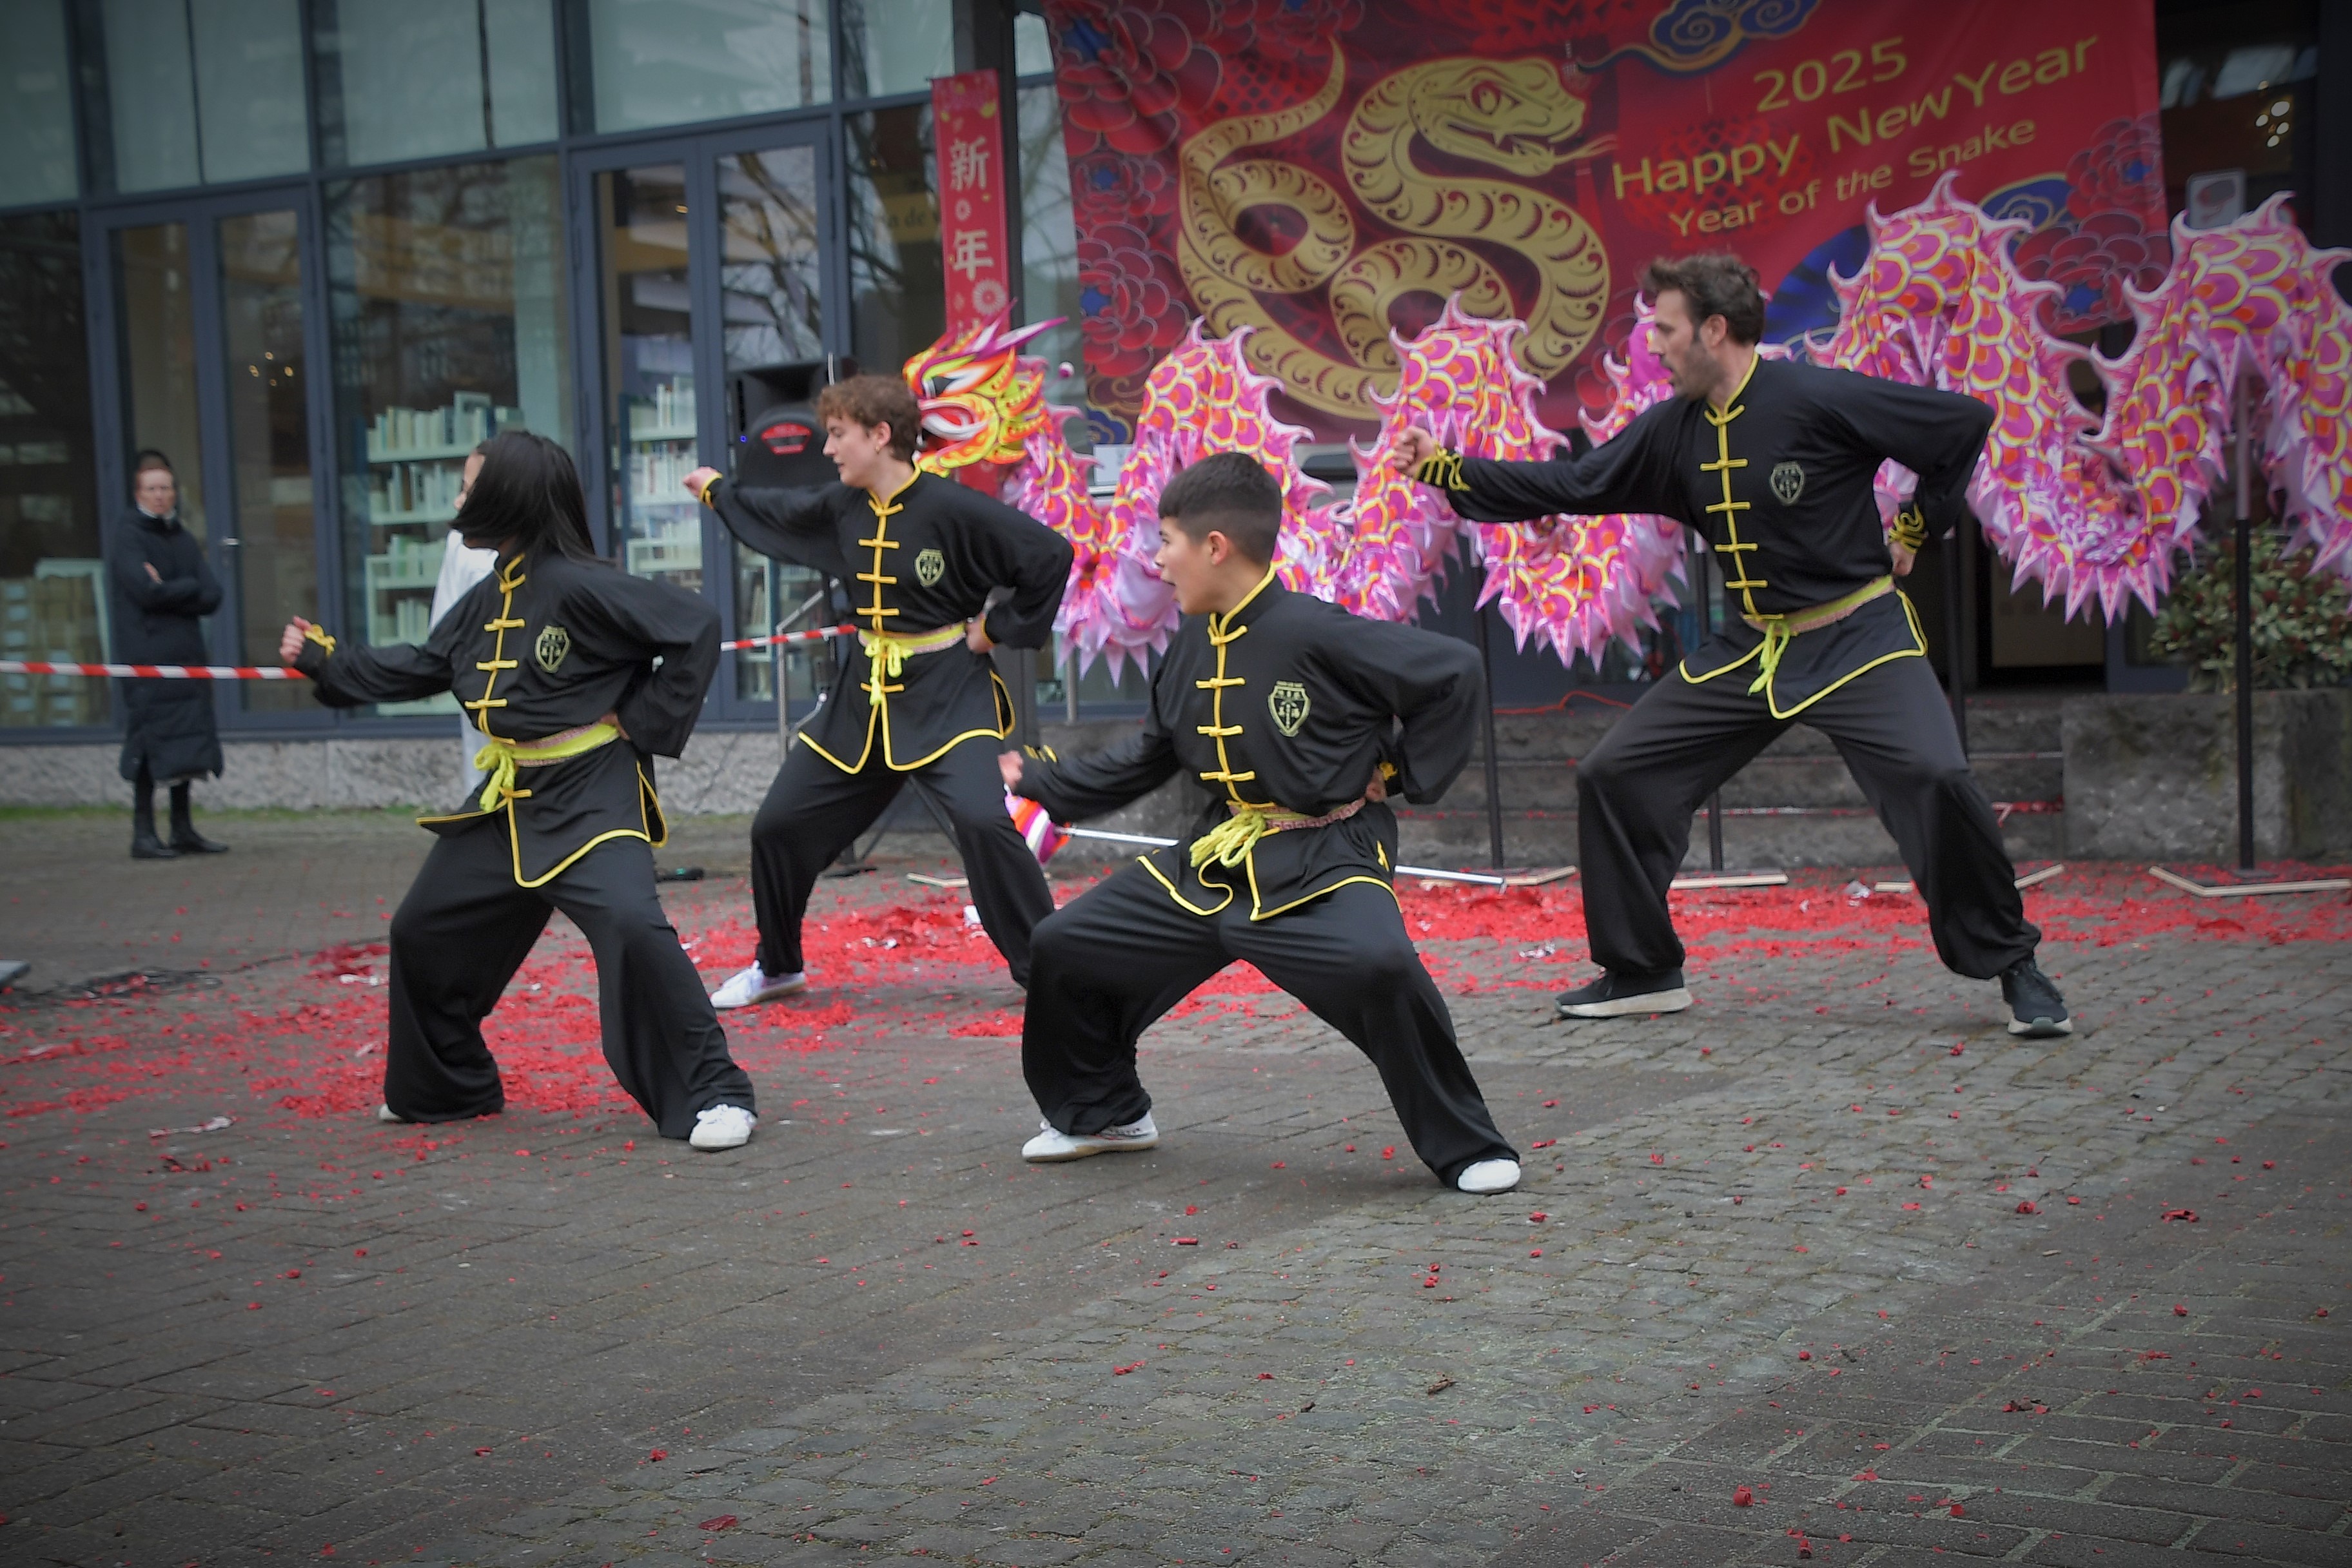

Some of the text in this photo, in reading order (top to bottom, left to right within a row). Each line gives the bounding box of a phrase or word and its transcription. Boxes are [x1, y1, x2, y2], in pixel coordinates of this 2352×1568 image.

[1754, 36, 1909, 112] 2025
[1612, 133, 1800, 201] Happy
[1669, 117, 2037, 238] Year of the Snake
[948, 135, 995, 342] 新年
